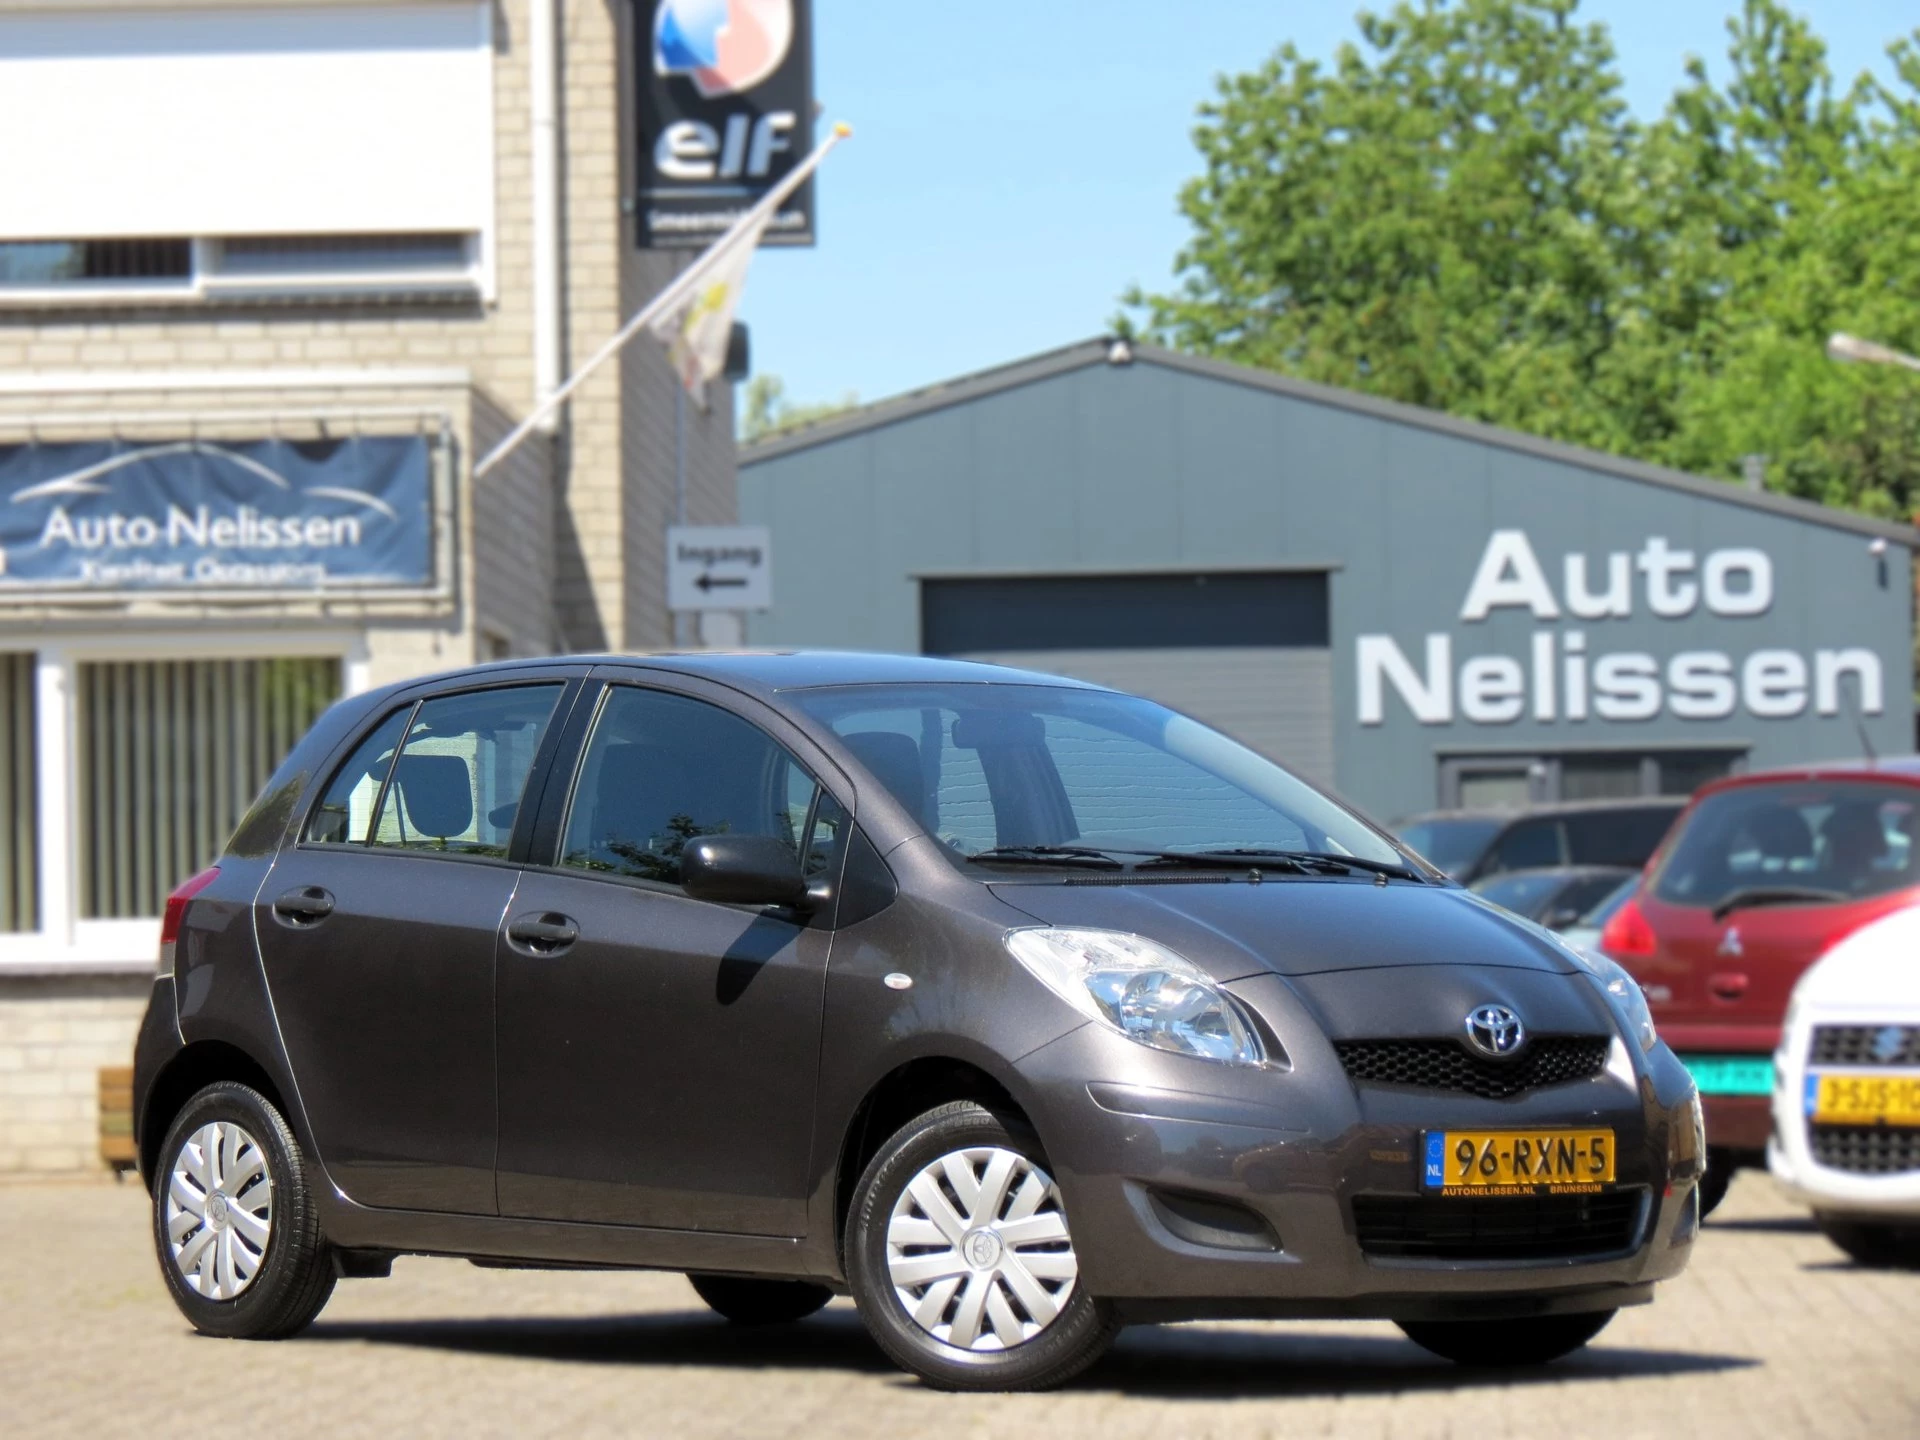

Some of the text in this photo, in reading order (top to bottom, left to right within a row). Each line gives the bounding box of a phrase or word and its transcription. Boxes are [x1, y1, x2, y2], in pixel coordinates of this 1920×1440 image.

[654, 111, 796, 179] elf
[38, 503, 361, 548] Auto Nelissen
[1459, 528, 1773, 621] Auto
[1355, 630, 1883, 726] Nelissen
[1427, 1163, 1442, 1177] NL
[1455, 1137, 1606, 1177] 96-RXN-5
[1442, 1184, 1602, 1197] AUTONELISSEN.NL BRUNSSUM
